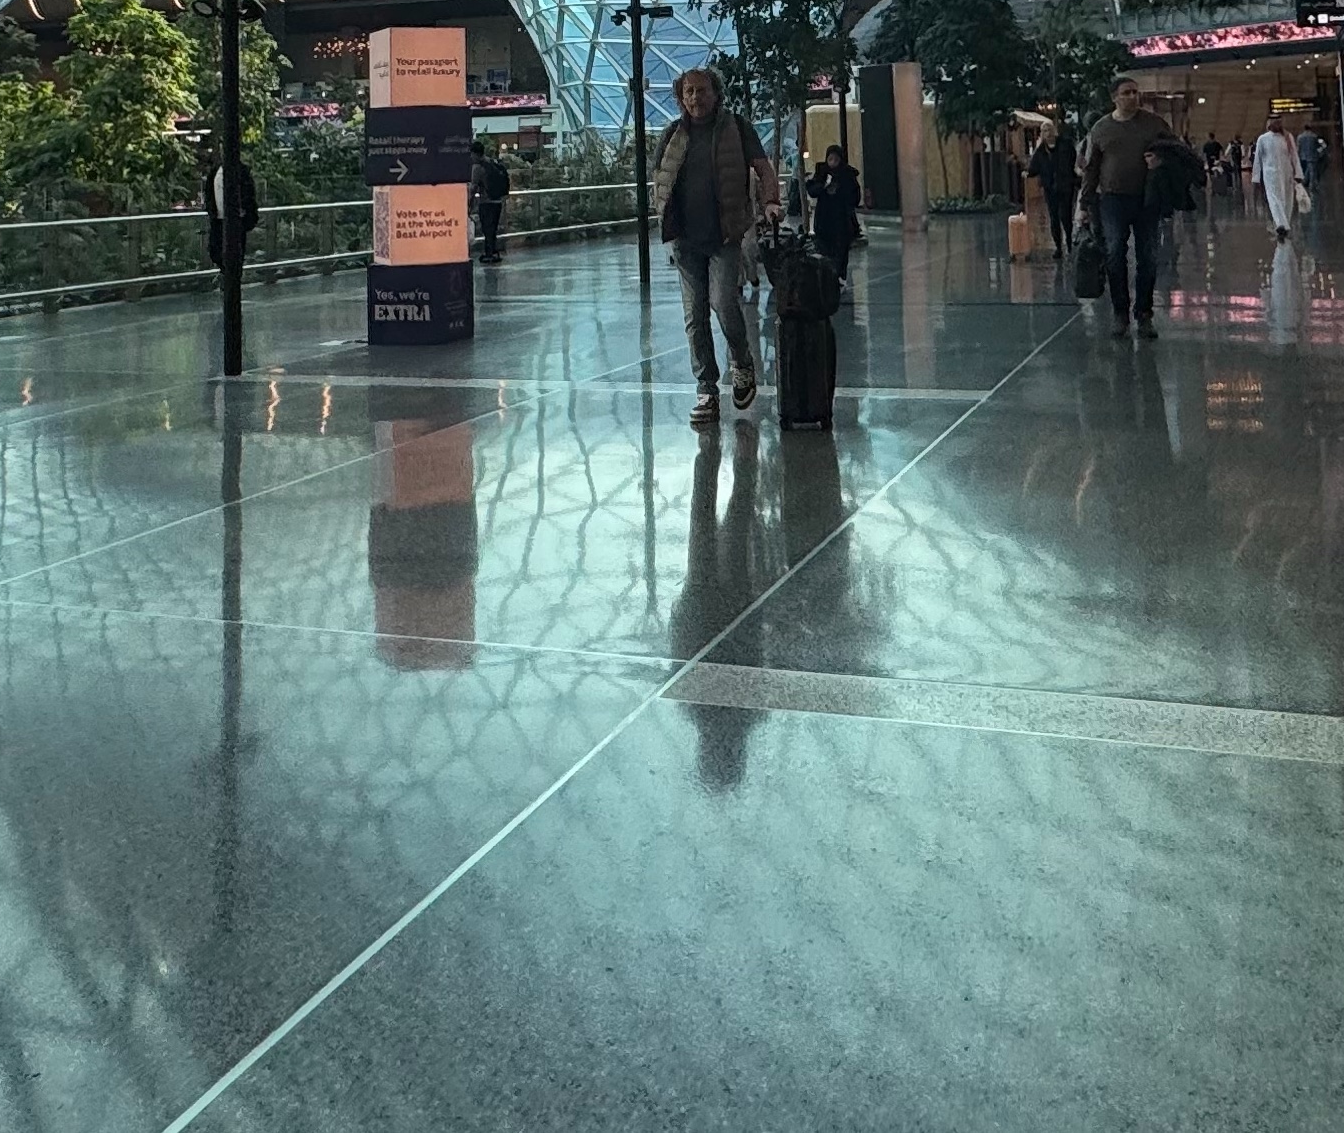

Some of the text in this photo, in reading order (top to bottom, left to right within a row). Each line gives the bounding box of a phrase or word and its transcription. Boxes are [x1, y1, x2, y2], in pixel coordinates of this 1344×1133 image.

[396, 57, 458, 67] Your passport
[396, 68, 460, 77] to retail luxury
[392, 136, 425, 145] therapy
[396, 210, 417, 219] Vote
[419, 209, 433, 218] for
[396, 218, 459, 229] as the World's
[396, 229, 453, 239] Best Airport
[374, 288, 430, 301] Yes, we're
[374, 304, 431, 322] EXTRA
